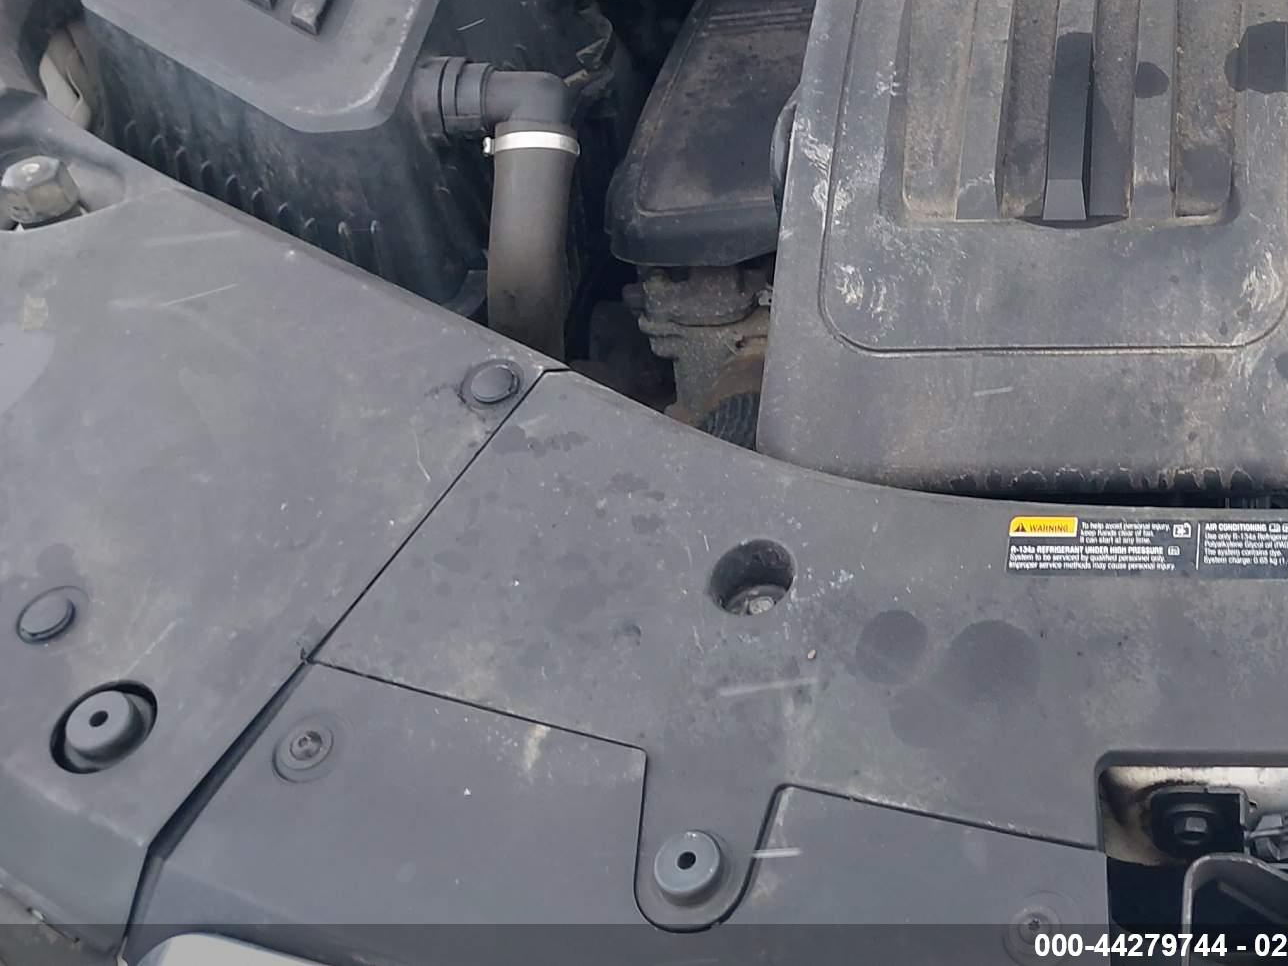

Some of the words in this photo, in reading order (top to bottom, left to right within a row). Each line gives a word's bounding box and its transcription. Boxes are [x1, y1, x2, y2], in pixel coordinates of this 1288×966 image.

[1030, 524, 1071, 533] WARNING
[1204, 522, 1218, 532] AIR
[1218, 522, 1267, 532] CONDITIONING
[1010, 545, 1036, 554] R-134a
[1036, 545, 1084, 554] REFRIGERANT
[1084, 545, 1109, 554] UNDER
[1110, 545, 1127, 554] HIGH
[1128, 545, 1164, 554] PRESSURE
